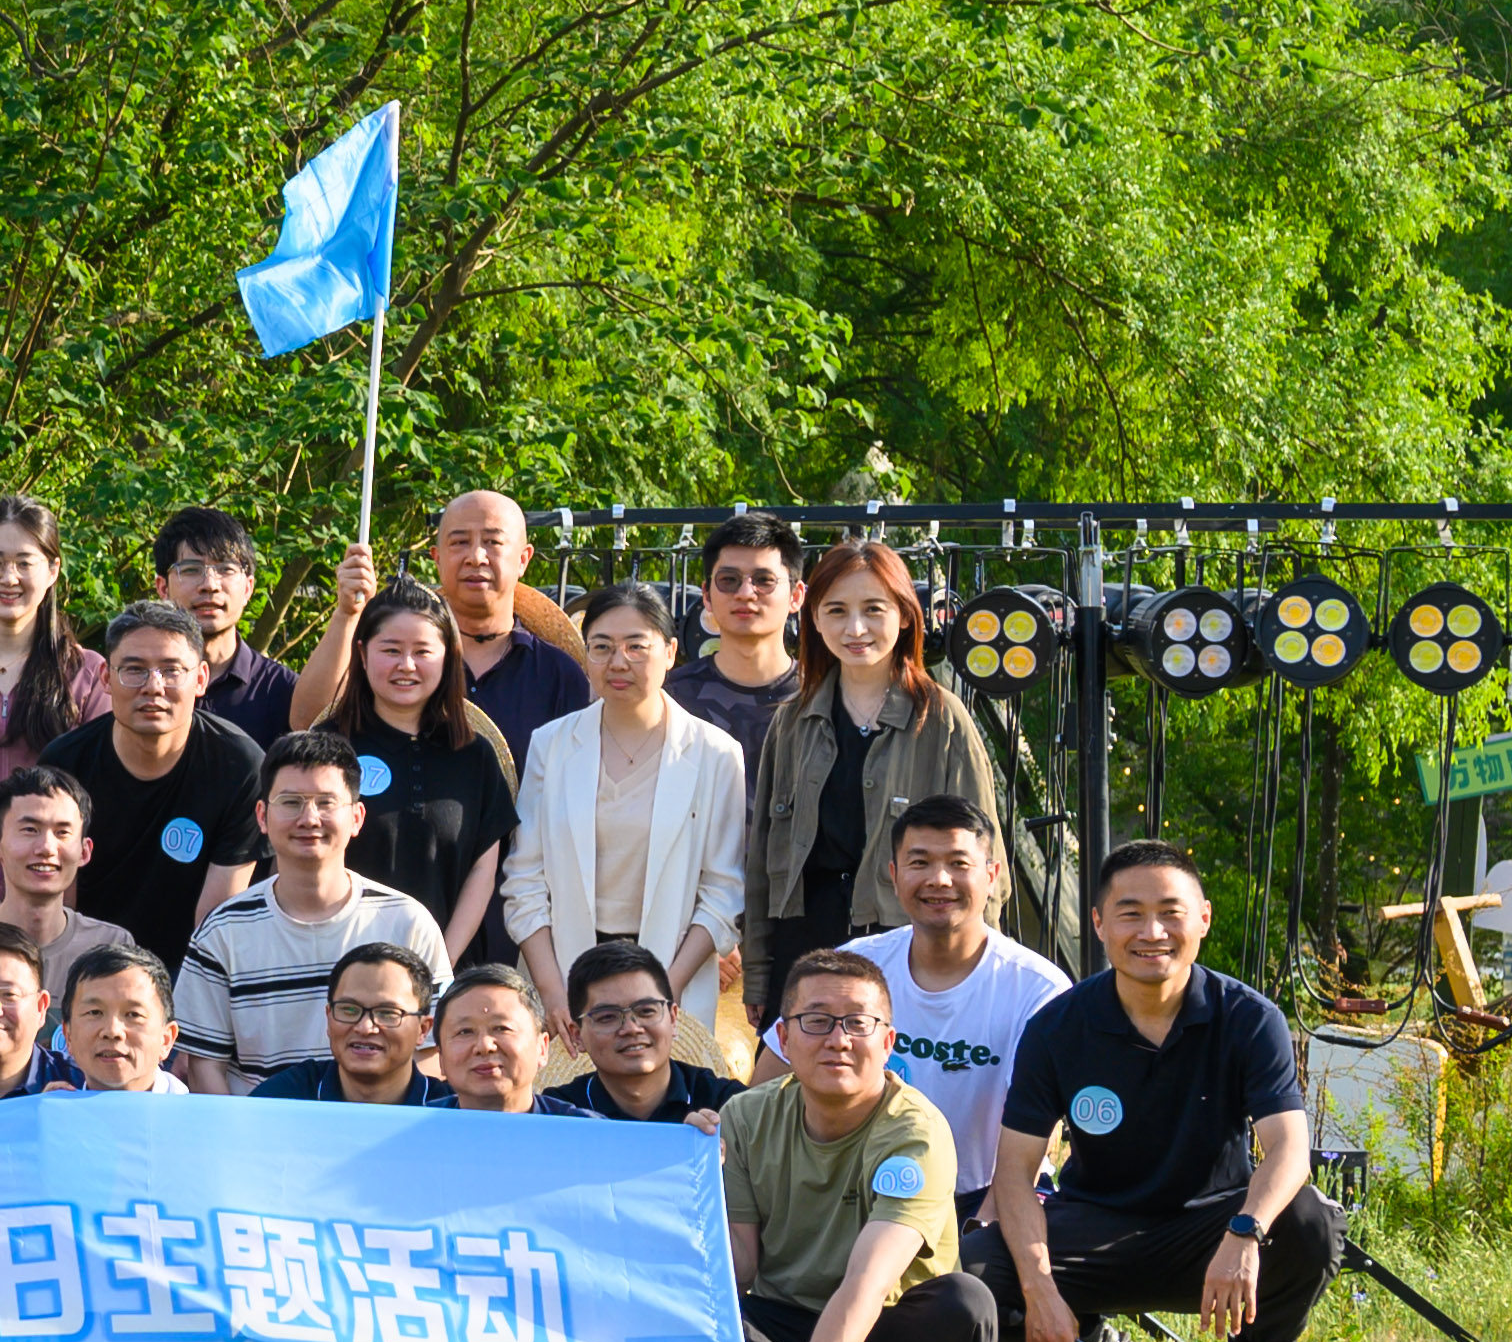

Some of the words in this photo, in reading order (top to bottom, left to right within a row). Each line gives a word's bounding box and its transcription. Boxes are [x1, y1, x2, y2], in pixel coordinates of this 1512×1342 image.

[165, 826, 200, 853] 07
[1075, 1096, 1116, 1123] 06
[878, 1166, 918, 1193] 09
